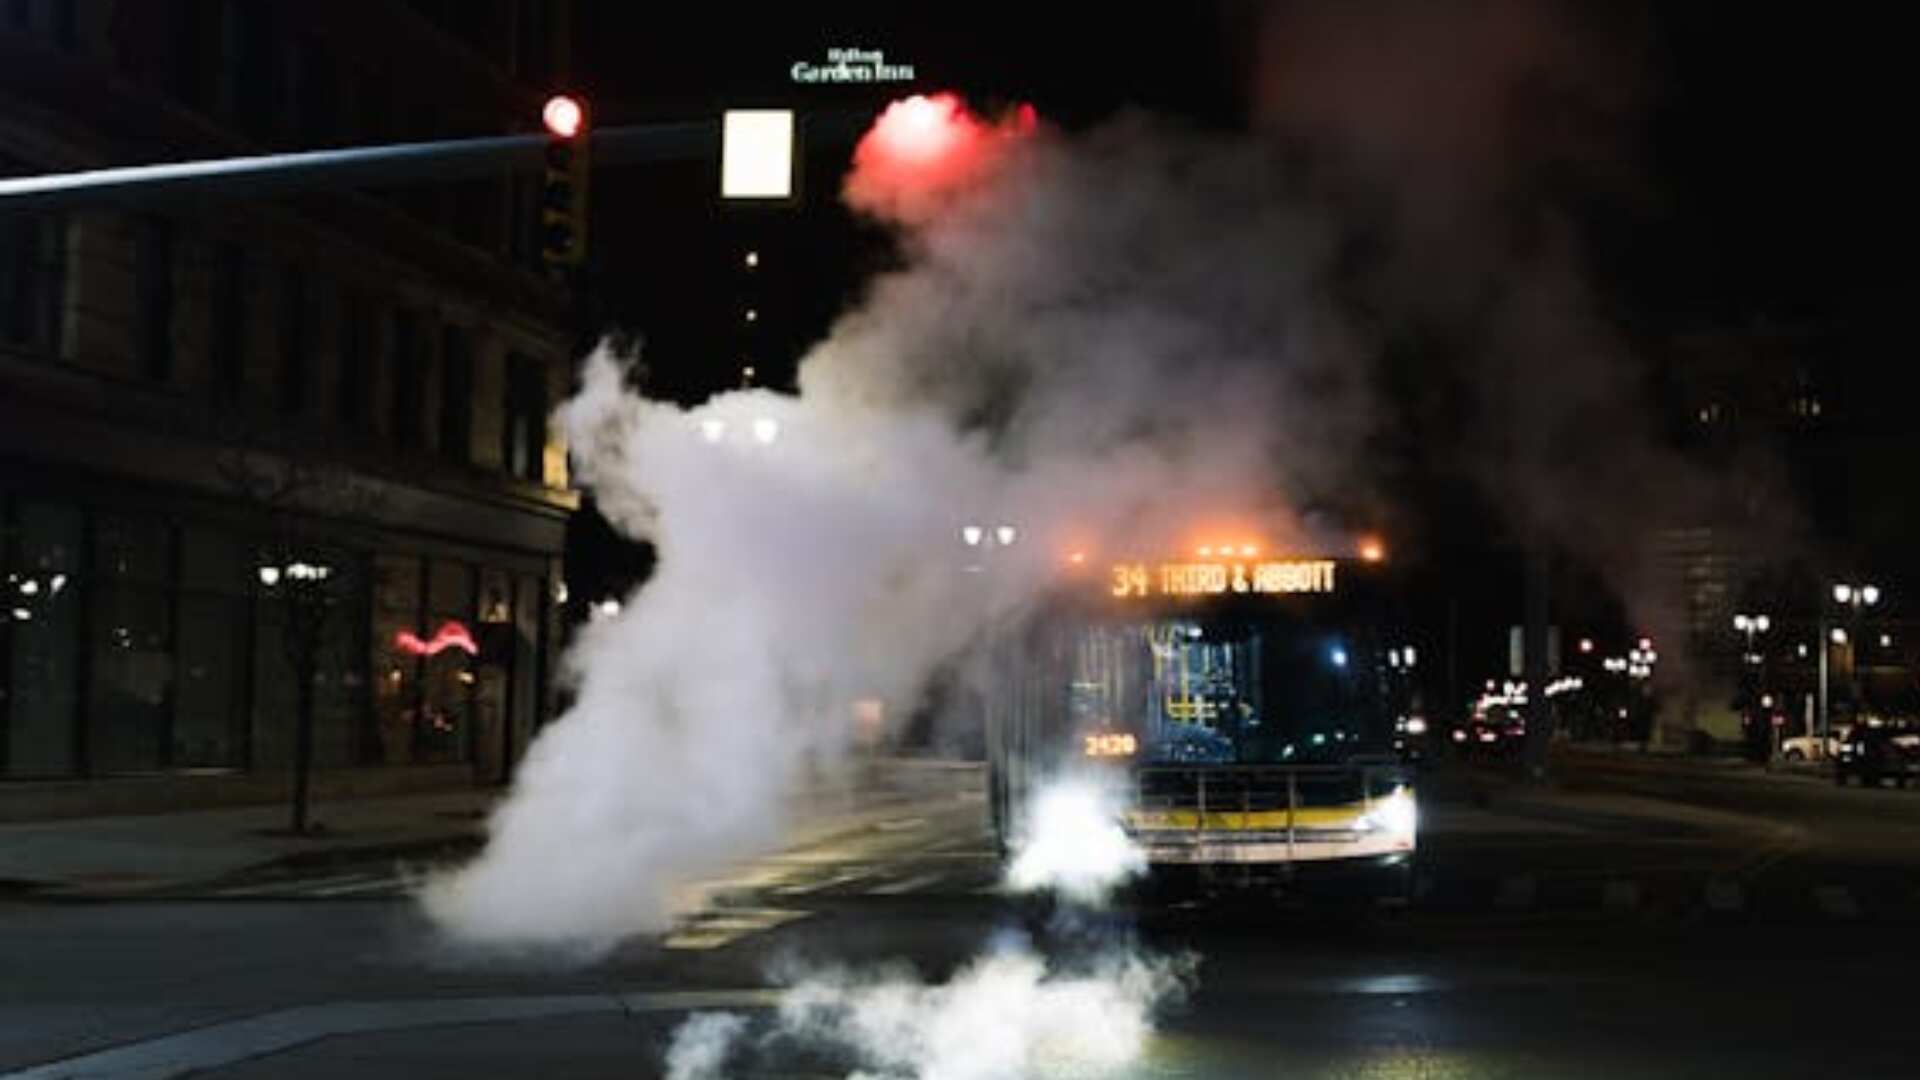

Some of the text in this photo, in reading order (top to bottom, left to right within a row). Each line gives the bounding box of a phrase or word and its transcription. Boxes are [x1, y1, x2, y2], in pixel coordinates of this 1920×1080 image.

[791, 61, 915, 82] Garden Inn
[1112, 560, 1335, 596] 34 THIRD & ABBOTT
